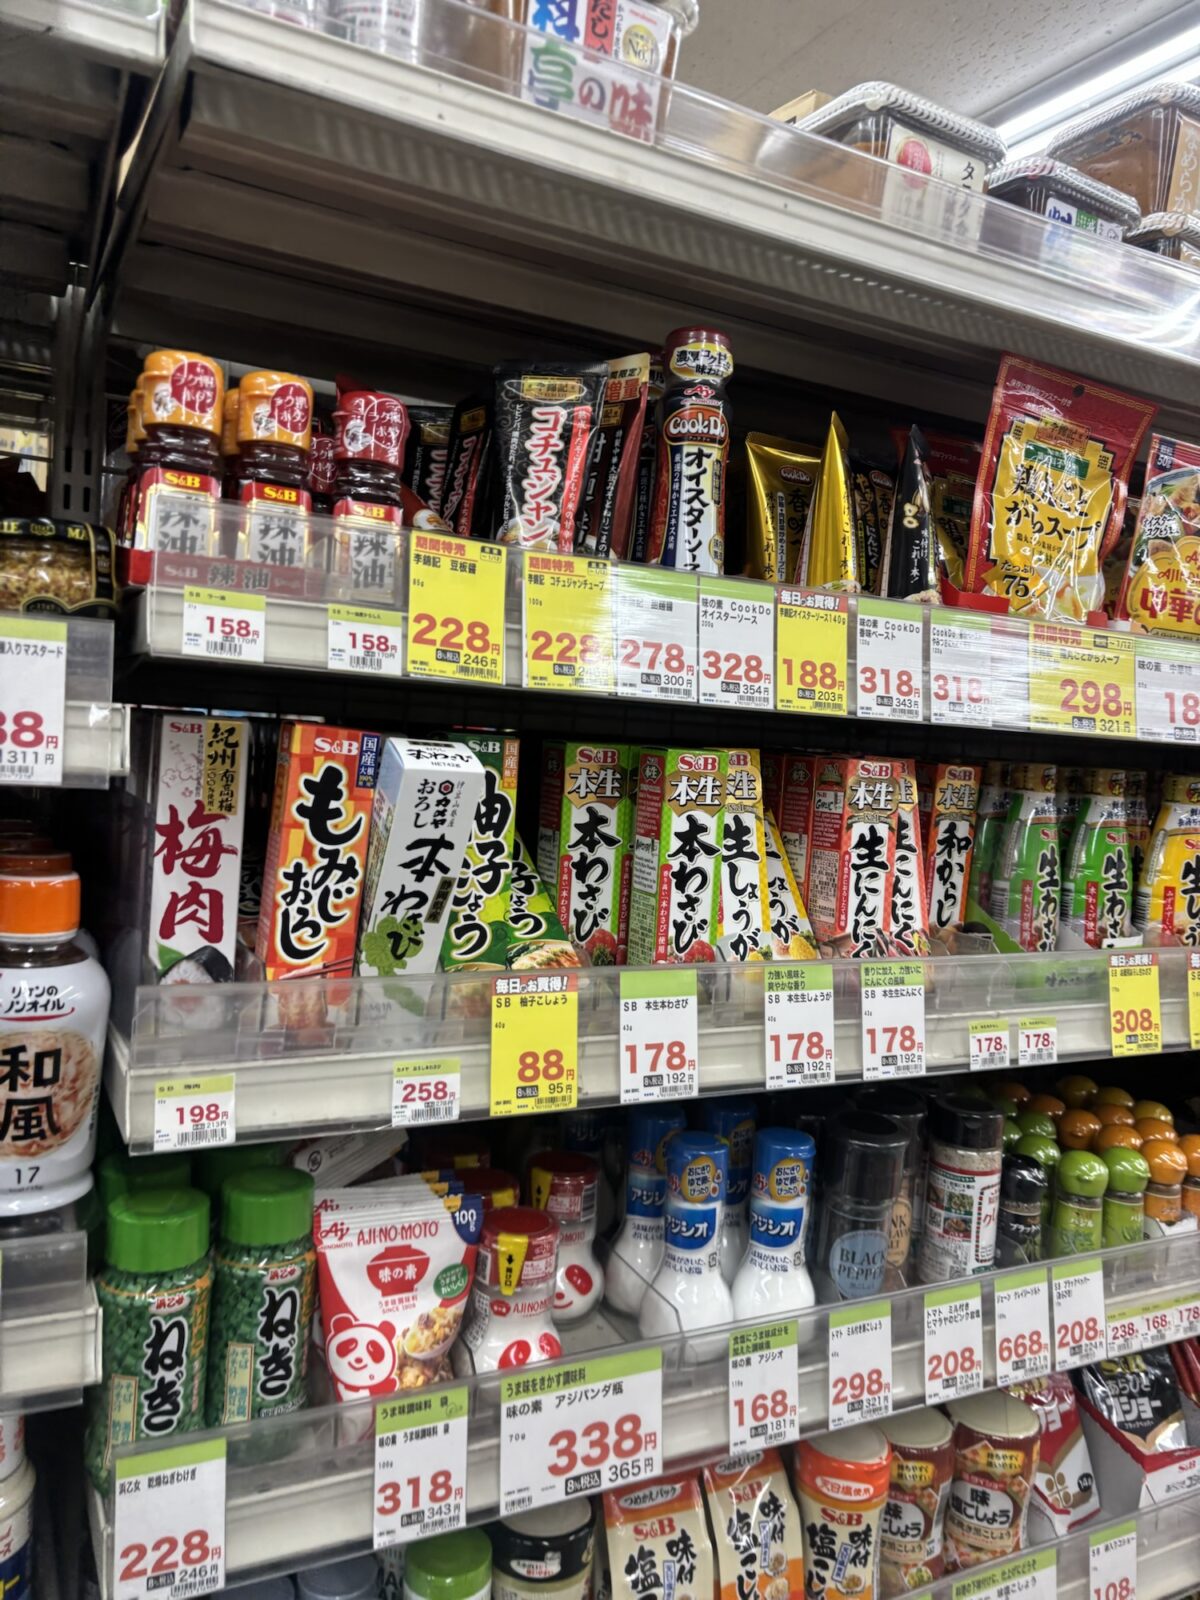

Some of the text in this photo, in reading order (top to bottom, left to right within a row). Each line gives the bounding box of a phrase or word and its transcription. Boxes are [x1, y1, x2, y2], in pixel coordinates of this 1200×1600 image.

[165, 472, 201, 488] S&B
[522, 406, 567, 545] コチュジャン
[264, 486, 297, 502] S&B
[353, 503, 385, 518] S&B
[416, 536, 466, 557] 期間特売
[528, 556, 575, 574] 期間特売
[702, 597, 771, 616] 味の素 CookDo
[702, 609, 758, 625] オイスターソース
[206, 616, 259, 638] 158円
[413, 613, 500, 655] 228円
[349, 632, 398, 653] 158円
[463, 653, 498, 668] 246円
[620, 638, 695, 676] 278円
[703, 650, 771, 684] 328円
[664, 675, 692, 688] 300円
[782, 658, 844, 691] 188円
[860, 666, 920, 698] 318円
[743, 684, 770, 696] 354円
[818, 691, 843, 703] 203円
[1060, 679, 1132, 717] 298円
[895, 697, 919, 709] 343円
[170, 722, 202, 733] S&B
[314, 737, 359, 756] S&B
[361, 736, 378, 767] 国産
[468, 740, 501, 754] S&B
[577, 748, 618, 764] S&B
[679, 756, 718, 771] S&B
[860, 763, 890, 778] S&B
[947, 769, 973, 781] S&B
[569, 767, 623, 799] 本生
[669, 775, 722, 807] 本生
[415, 778, 438, 829] おろし
[851, 781, 894, 811] 本生
[939, 784, 976, 810] 本生
[295, 765, 364, 923] もみじ
[153, 799, 238, 944] 梅肉
[567, 807, 623, 942] 本わさび
[935, 822, 973, 928] 和からし
[666, 814, 722, 954] 本わさび
[721, 814, 761, 961] 生しょうが
[850, 824, 889, 957] 生にんにく
[380, 833, 455, 960] 本わさび
[279, 861, 327, 960] おろし
[768, 970, 806, 980] 力強い風味と
[520, 997, 568, 1008] 柚子こしょう
[645, 999, 689, 1011] 本生本わさび
[787, 992, 832, 1004] 本生生しょうが
[882, 988, 923, 999] 本生生にんにく
[1113, 1008, 1160, 1034] 308円
[770, 1031, 832, 1062] 178円
[866, 1025, 923, 1055] 178円
[518, 1049, 574, 1083] 88円
[625, 1041, 696, 1074] 178円
[806, 1061, 831, 1072] 192円
[899, 1054, 922, 1064] 192円
[548, 1083, 573, 1095] 95円
[666, 1073, 694, 1084] 192円
[0, 1047, 63, 1142] 和風
[402, 1081, 456, 1103] 258円
[176, 1103, 229, 1124] 198円
[14, 1166, 41, 1185] 17
[666, 1214, 709, 1237] アジシオ
[752, 1214, 795, 1236] アジシオ
[379, 1263, 418, 1283] 味の素
[259, 1289, 300, 1397] ねぎ
[1057, 1317, 1104, 1349] 208円
[758, 1350, 784, 1364] アジシオ
[998, 1330, 1049, 1363] 668円
[142, 1318, 188, 1432] ねぎ
[928, 1346, 982, 1381] 208円
[506, 1366, 586, 1398] うま味をきかす調味料
[832, 1368, 891, 1406] 298円
[381, 1399, 432, 1420] うま味調味料
[506, 1381, 625, 1419] 味の素 アジパンダ瓶
[734, 1389, 797, 1427] 168円
[770, 1418, 796, 1431] 181円
[378, 1435, 397, 1448] 味の素
[548, 1414, 657, 1477] 338円
[608, 1457, 655, 1483] 365円
[376, 1470, 464, 1516] 318円
[623, 1485, 678, 1506] つめかえパック
[728, 1481, 764, 1503] S&B
[427, 1503, 461, 1520] 343円
[760, 1492, 787, 1543] 味付
[820, 1507, 863, 1526] S&B
[633, 1517, 676, 1541] S&B
[119, 1529, 222, 1582] 228円
[666, 1528, 697, 1585] 味付
[848, 1524, 873, 1569] 味付
[179, 1563, 219, 1584] 246円
